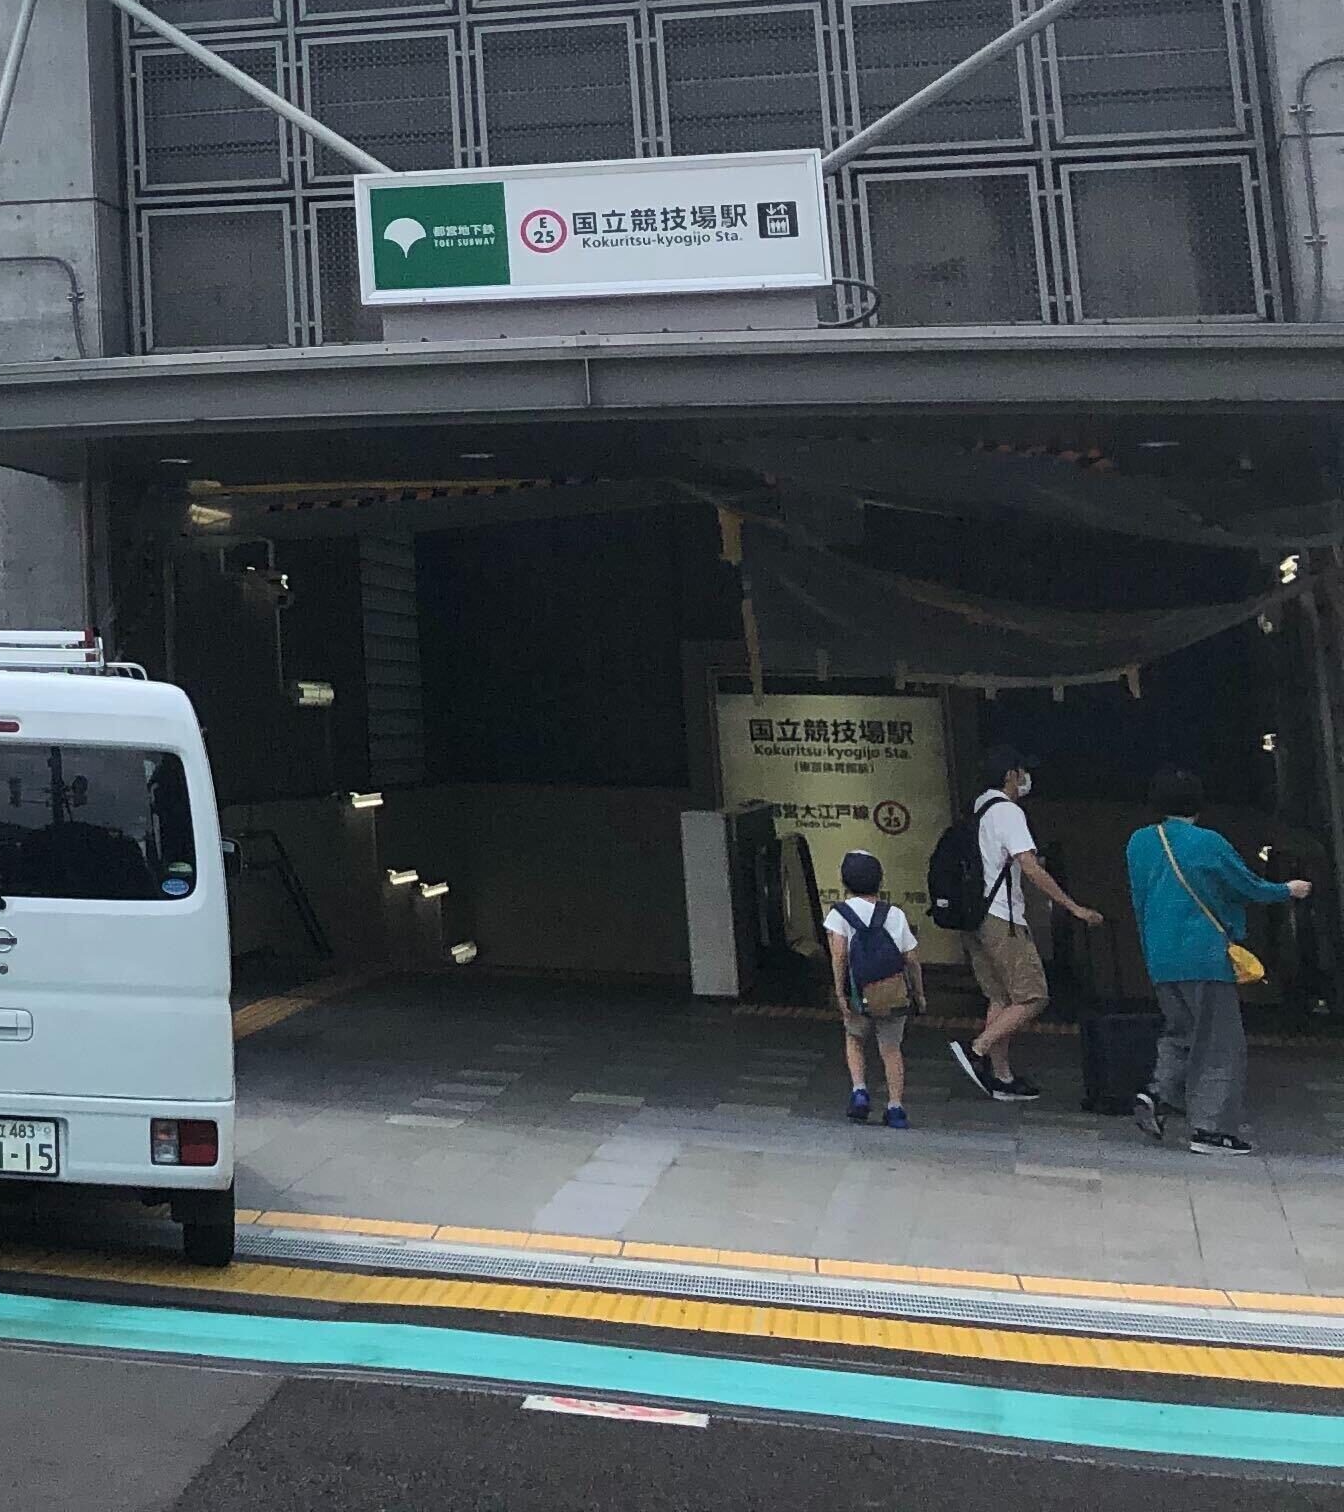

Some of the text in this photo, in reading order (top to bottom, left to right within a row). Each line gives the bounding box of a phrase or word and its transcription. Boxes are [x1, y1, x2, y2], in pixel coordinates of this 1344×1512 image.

[539, 217, 547, 229] E
[572, 203, 748, 236] 国立競技場駅
[434, 237, 496, 248] TOEI SUBWAY
[533, 230, 555, 244] 25
[582, 230, 743, 249] Kokuritsu-kyogijo Sta.
[749, 718, 914, 745] 国立競技場駅
[754, 743, 911, 760] Kokuritsu-kyogijo Sta.
[9, 1122, 35, 1139] 483
